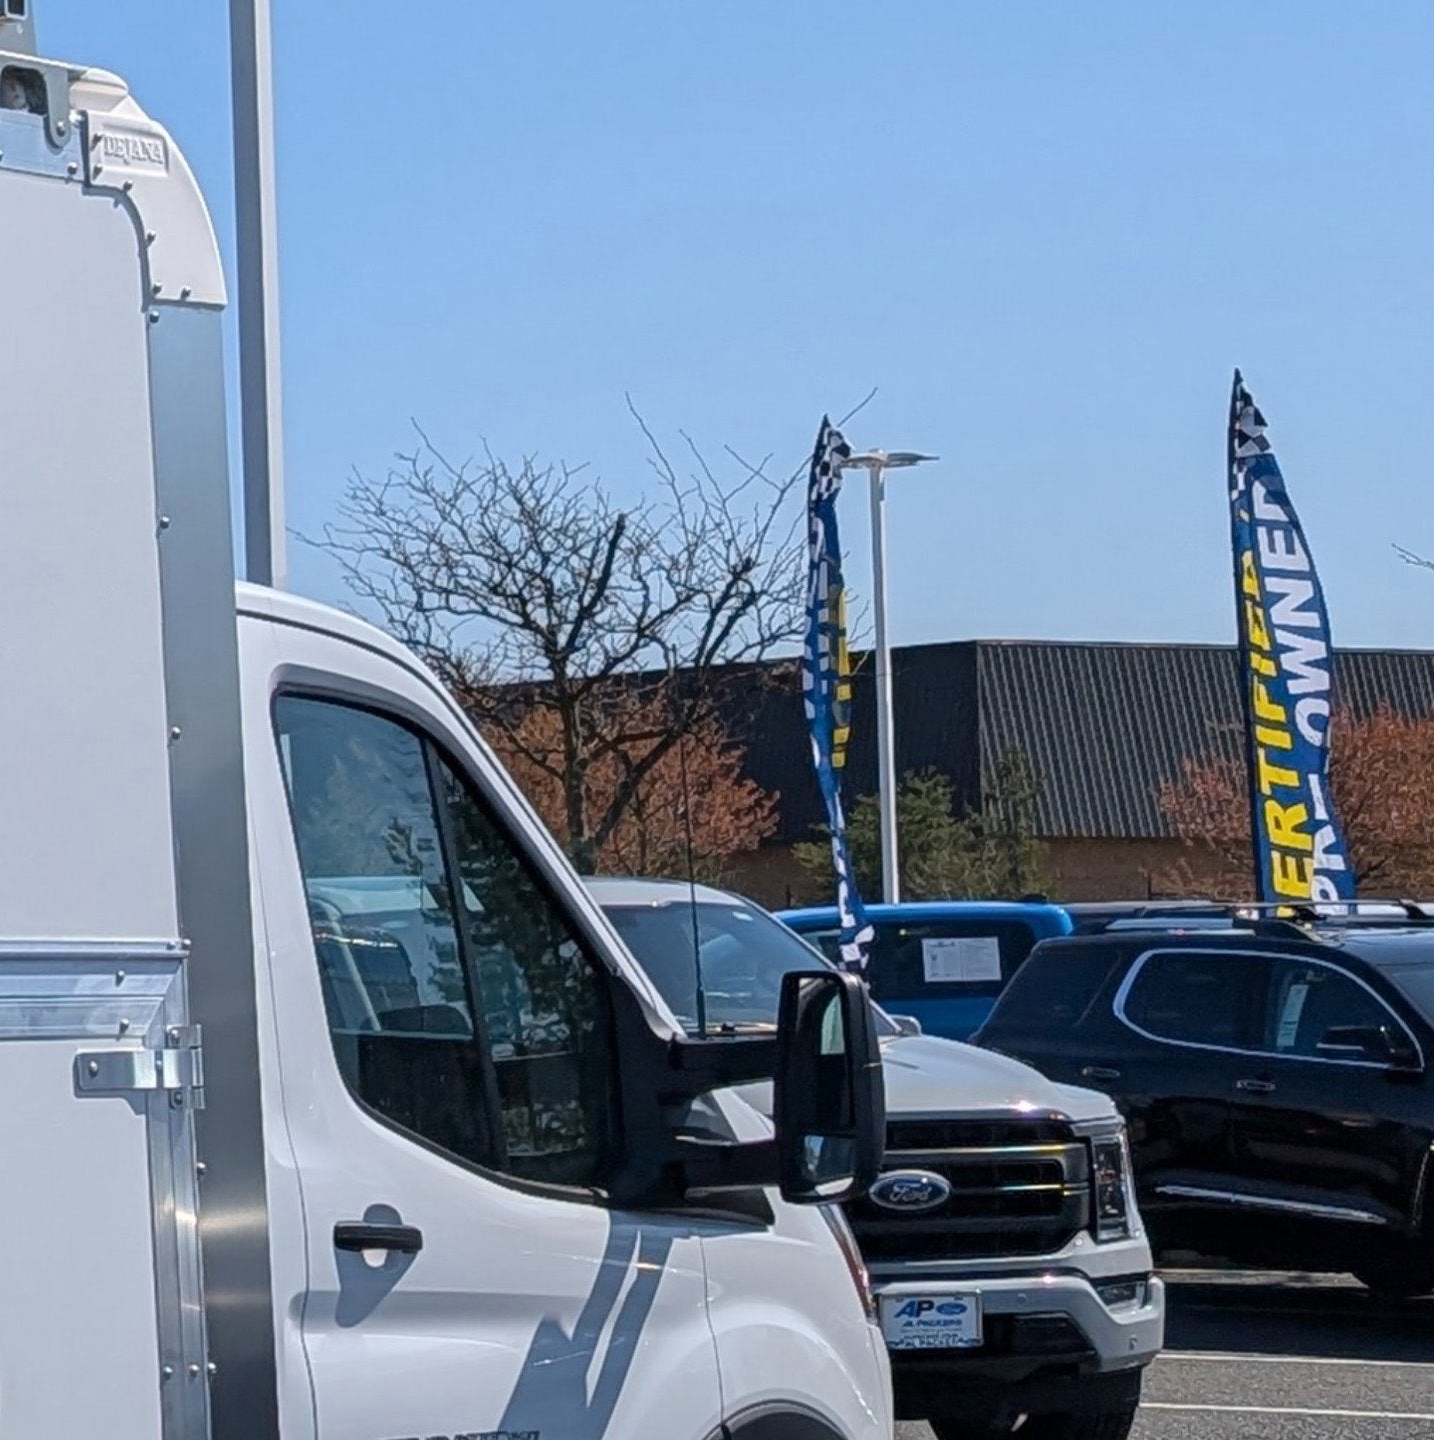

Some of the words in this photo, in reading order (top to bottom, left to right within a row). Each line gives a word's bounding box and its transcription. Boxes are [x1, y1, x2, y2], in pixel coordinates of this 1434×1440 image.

[103, 133, 164, 166] DEJANA
[888, 1181, 932, 1203] Ford
[894, 1300, 935, 1319] AP
